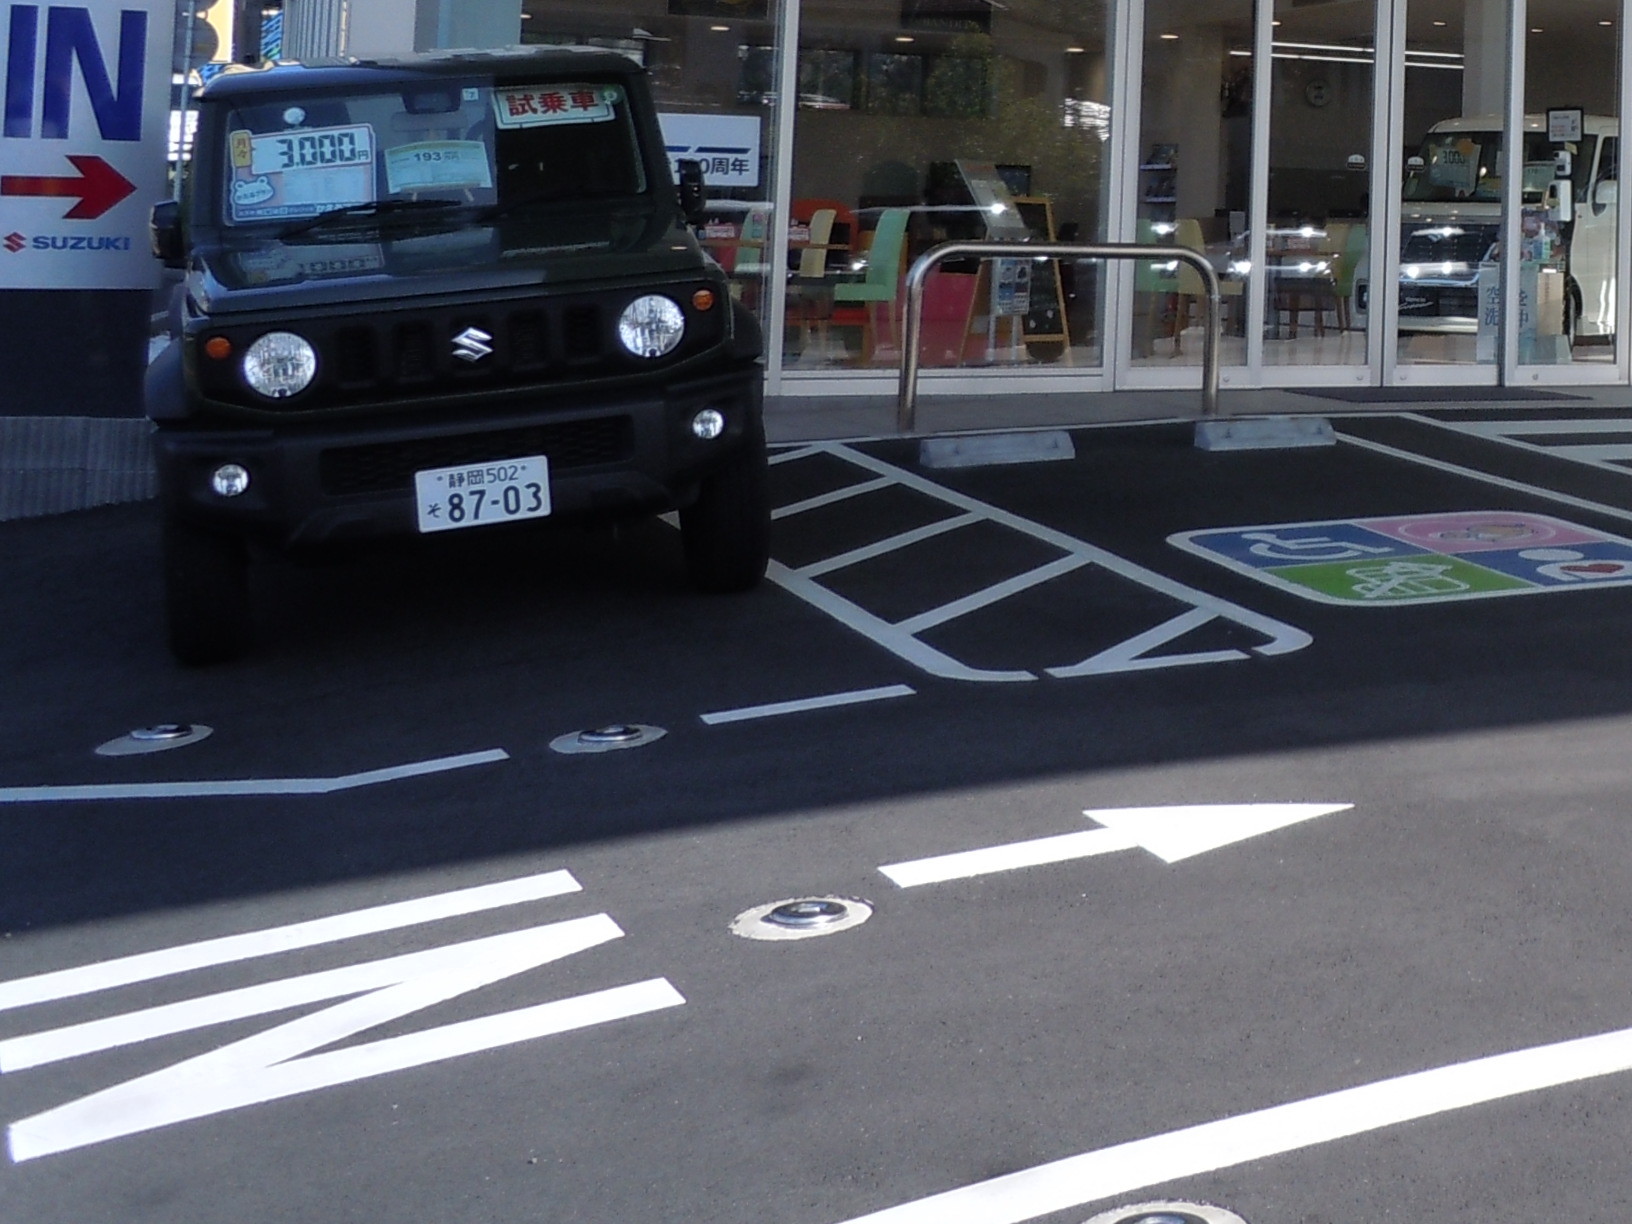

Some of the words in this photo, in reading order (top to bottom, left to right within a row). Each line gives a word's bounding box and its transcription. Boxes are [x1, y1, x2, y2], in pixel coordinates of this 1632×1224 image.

[4, 4, 147, 141] IN
[506, 90, 599, 116] 試乗車
[32, 236, 130, 250] SUZUKI
[427, 502, 442, 518] そ
[448, 482, 542, 523] 87-03
